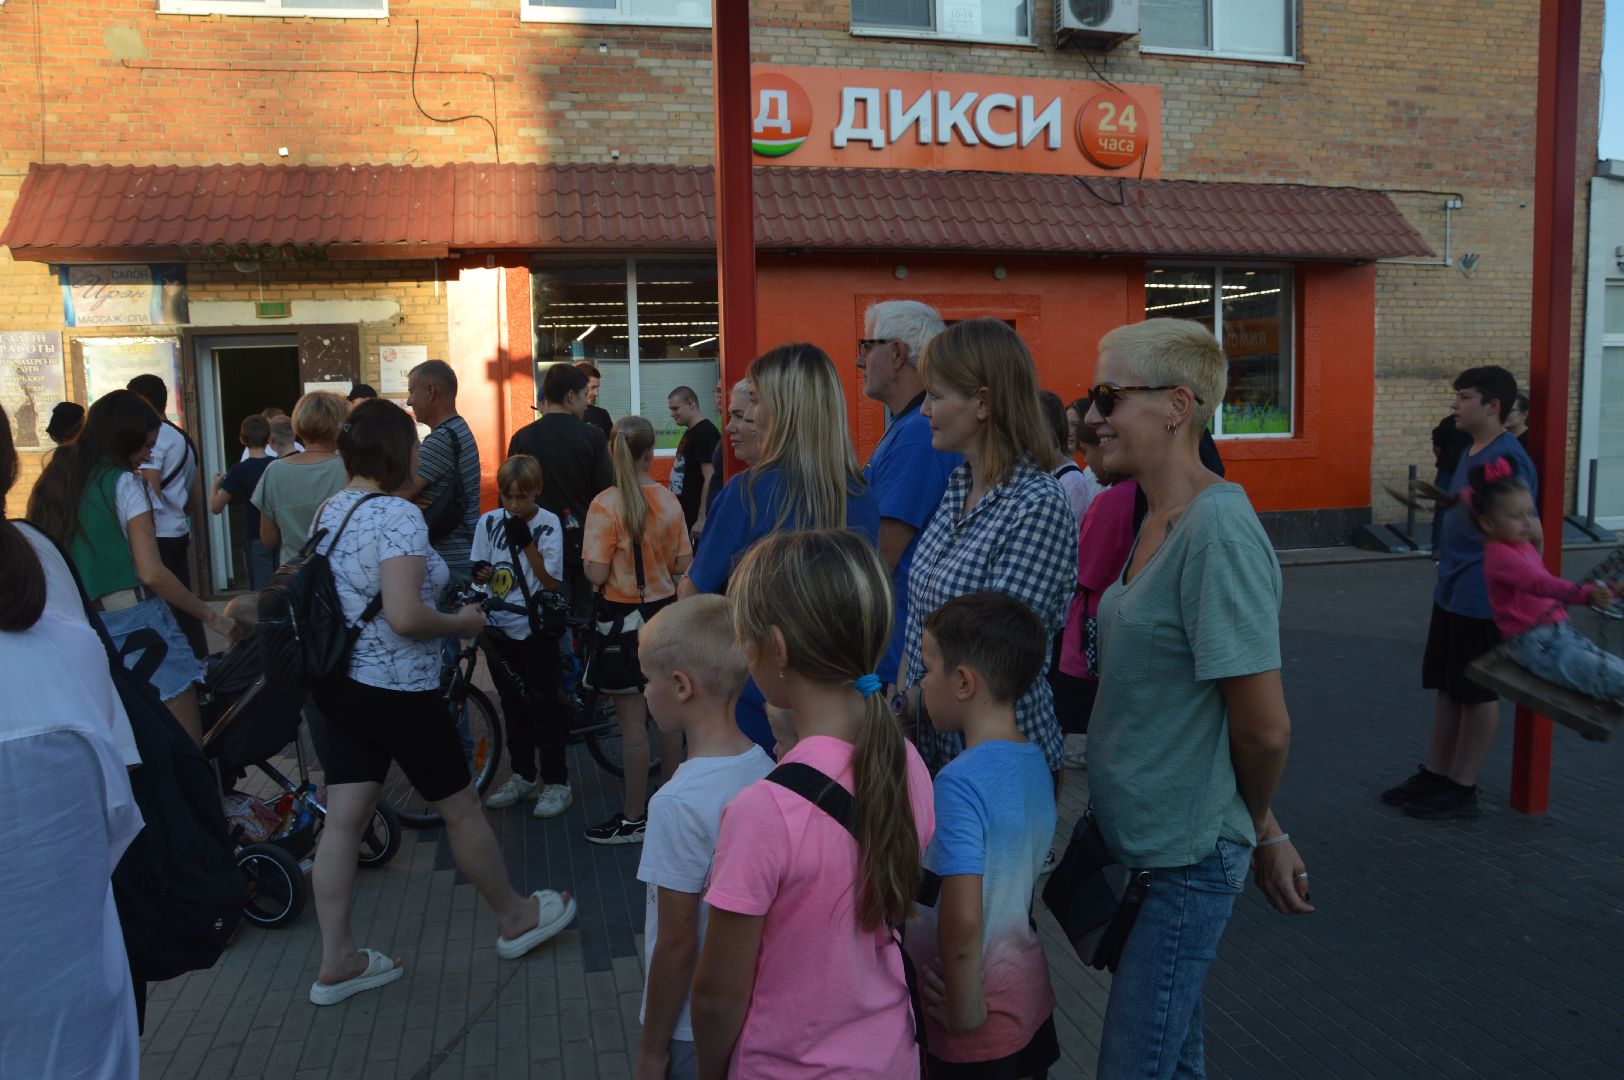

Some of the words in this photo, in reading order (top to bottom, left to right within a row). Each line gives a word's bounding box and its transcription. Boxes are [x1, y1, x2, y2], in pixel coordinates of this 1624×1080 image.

[833, 87, 1062, 150] ДИКСИ
[1097, 102, 1137, 134] 24
[1098, 135, 1135, 153] часа
[112, 270, 148, 280] САЛОН
[77, 314, 122, 324] МАССАЖ
[128, 313, 148, 323] СПА
